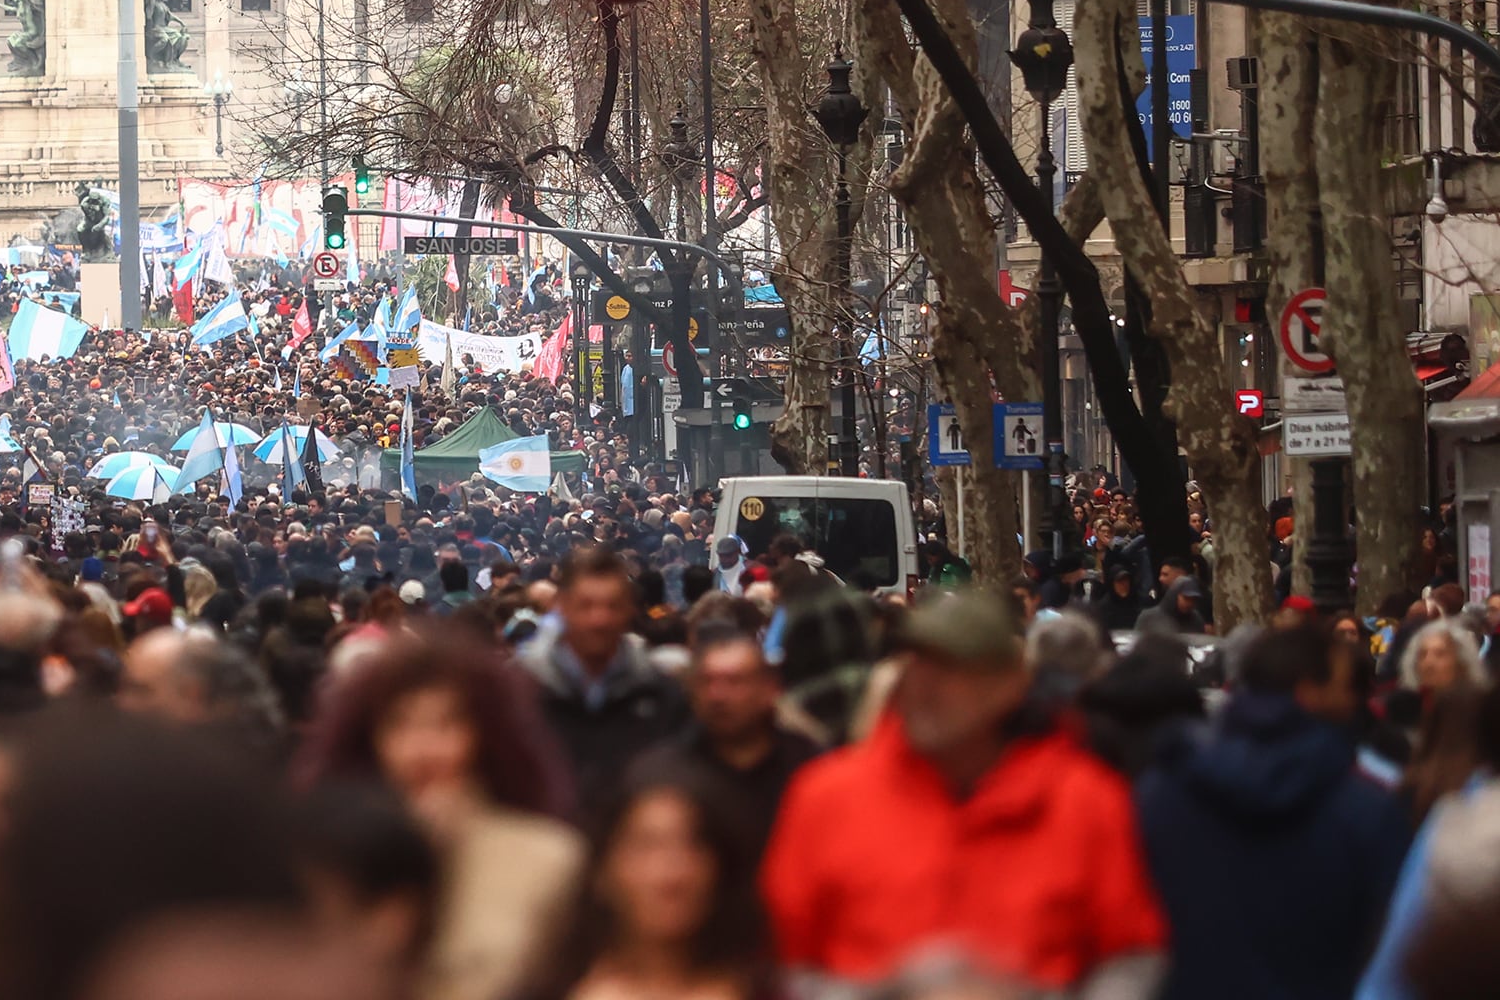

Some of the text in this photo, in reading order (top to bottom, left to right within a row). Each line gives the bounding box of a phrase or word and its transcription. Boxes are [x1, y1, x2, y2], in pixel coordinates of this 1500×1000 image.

[415, 238, 507, 254] SAN JOSE
[743, 319, 765, 329] eña
[1289, 438, 1302, 448] de
[1305, 437, 1311, 447] 7
[1323, 437, 1335, 446] 21
[744, 502, 762, 516] 110
